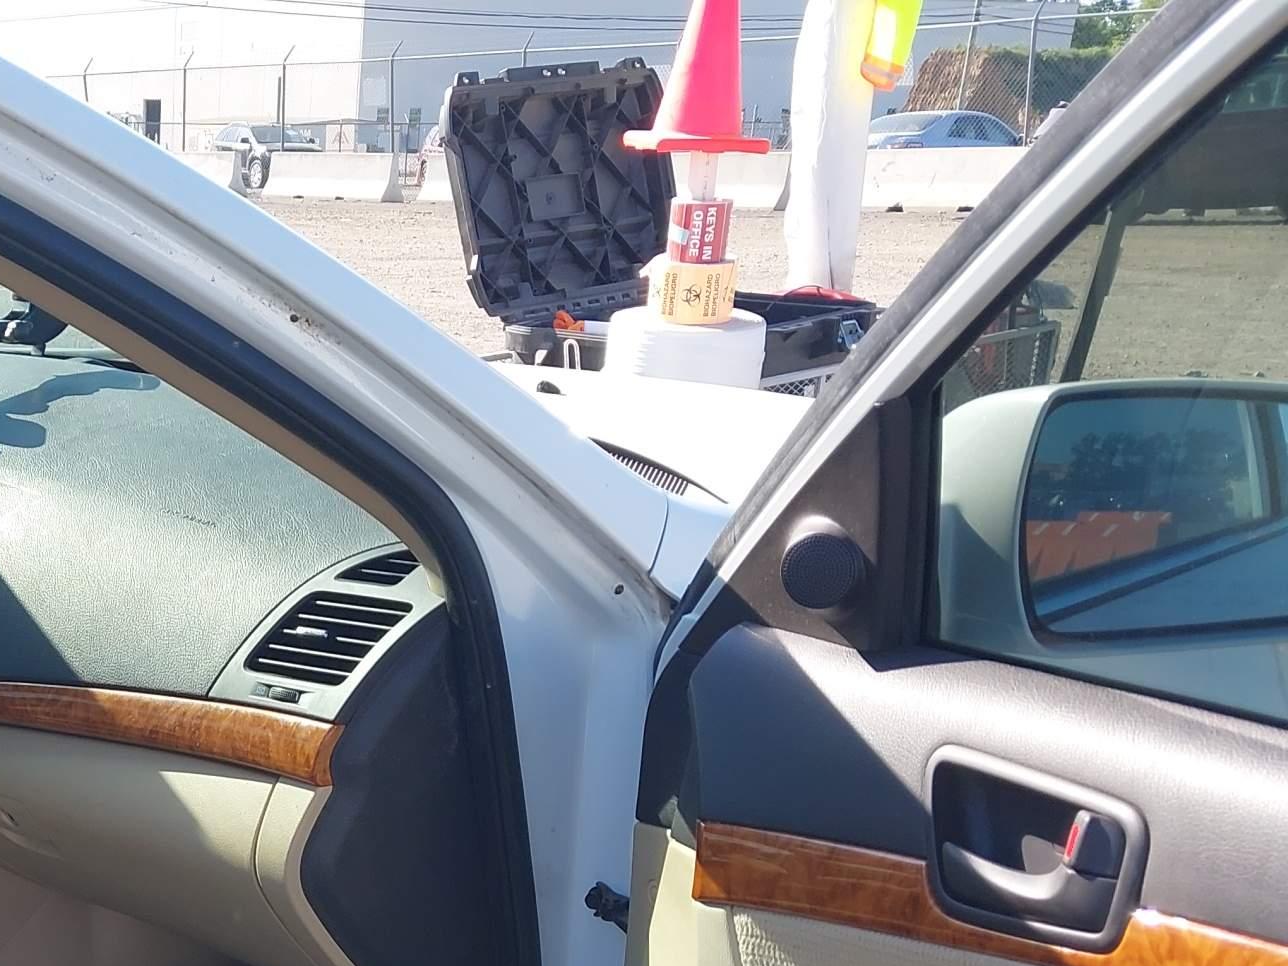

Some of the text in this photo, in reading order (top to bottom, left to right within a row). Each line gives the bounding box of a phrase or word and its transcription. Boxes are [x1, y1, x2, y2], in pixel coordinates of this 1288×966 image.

[689, 211, 703, 257] OFFICE
[702, 207, 717, 260] KEYS IN
[668, 273, 678, 316] BIOPELIGRO
[703, 274, 713, 317] BIOHAZARD
[711, 273, 720, 317] BIOPELIGRO
